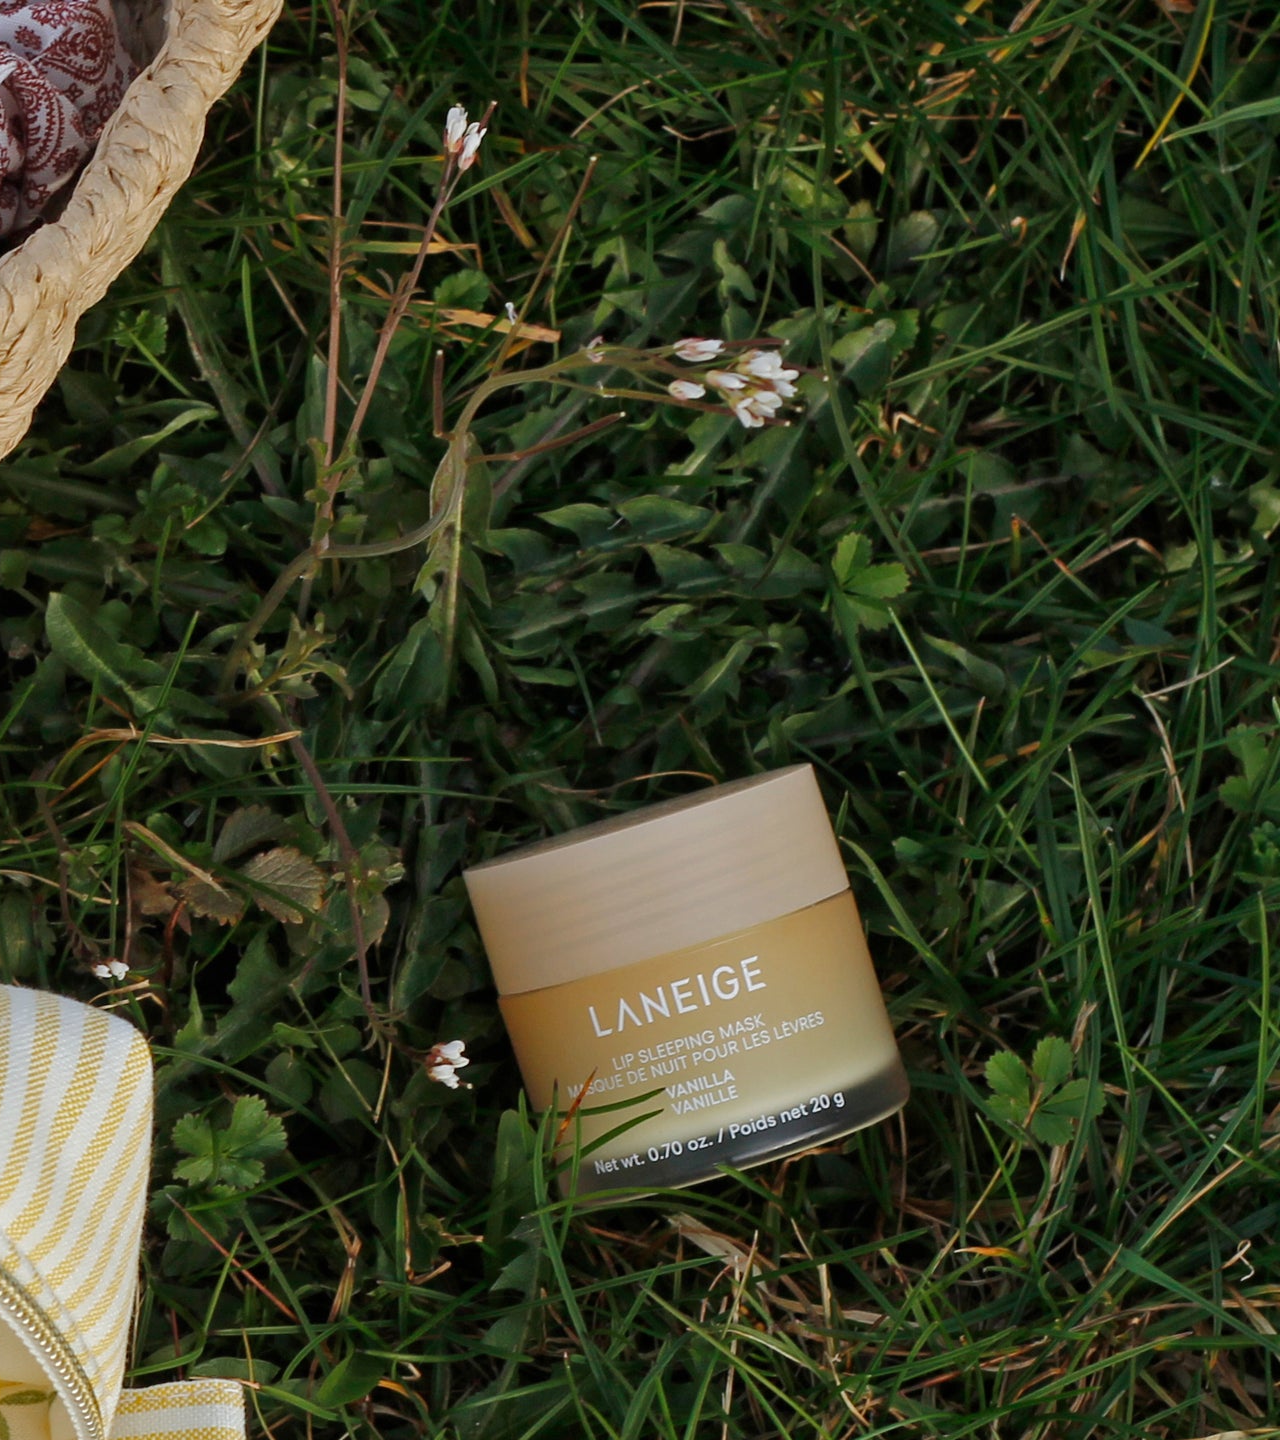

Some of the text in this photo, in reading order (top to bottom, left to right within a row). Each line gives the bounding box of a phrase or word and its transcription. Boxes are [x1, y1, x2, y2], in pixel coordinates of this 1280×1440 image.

[588, 955, 767, 1039] LANEIGE
[611, 1013, 766, 1071] LIP SLEEPING MASK
[626, 1070, 649, 1084] DE
[650, 1055, 689, 1078] NUIT
[692, 1043, 740, 1067] POUR
[742, 1030, 771, 1052] LES
[773, 1010, 826, 1044] LÈVRES
[665, 1069, 736, 1101] VANILLA
[671, 1085, 739, 1116] VANILLE
[594, 1157, 619, 1176] Net
[621, 1151, 646, 1168] wt.
[647, 1140, 684, 1162] 0.70
[687, 1135, 714, 1152] oz.
[728, 1113, 778, 1142] Poids
[780, 1104, 808, 1126] net
[809, 1095, 832, 1116] 20
[833, 1090, 846, 1109] g
